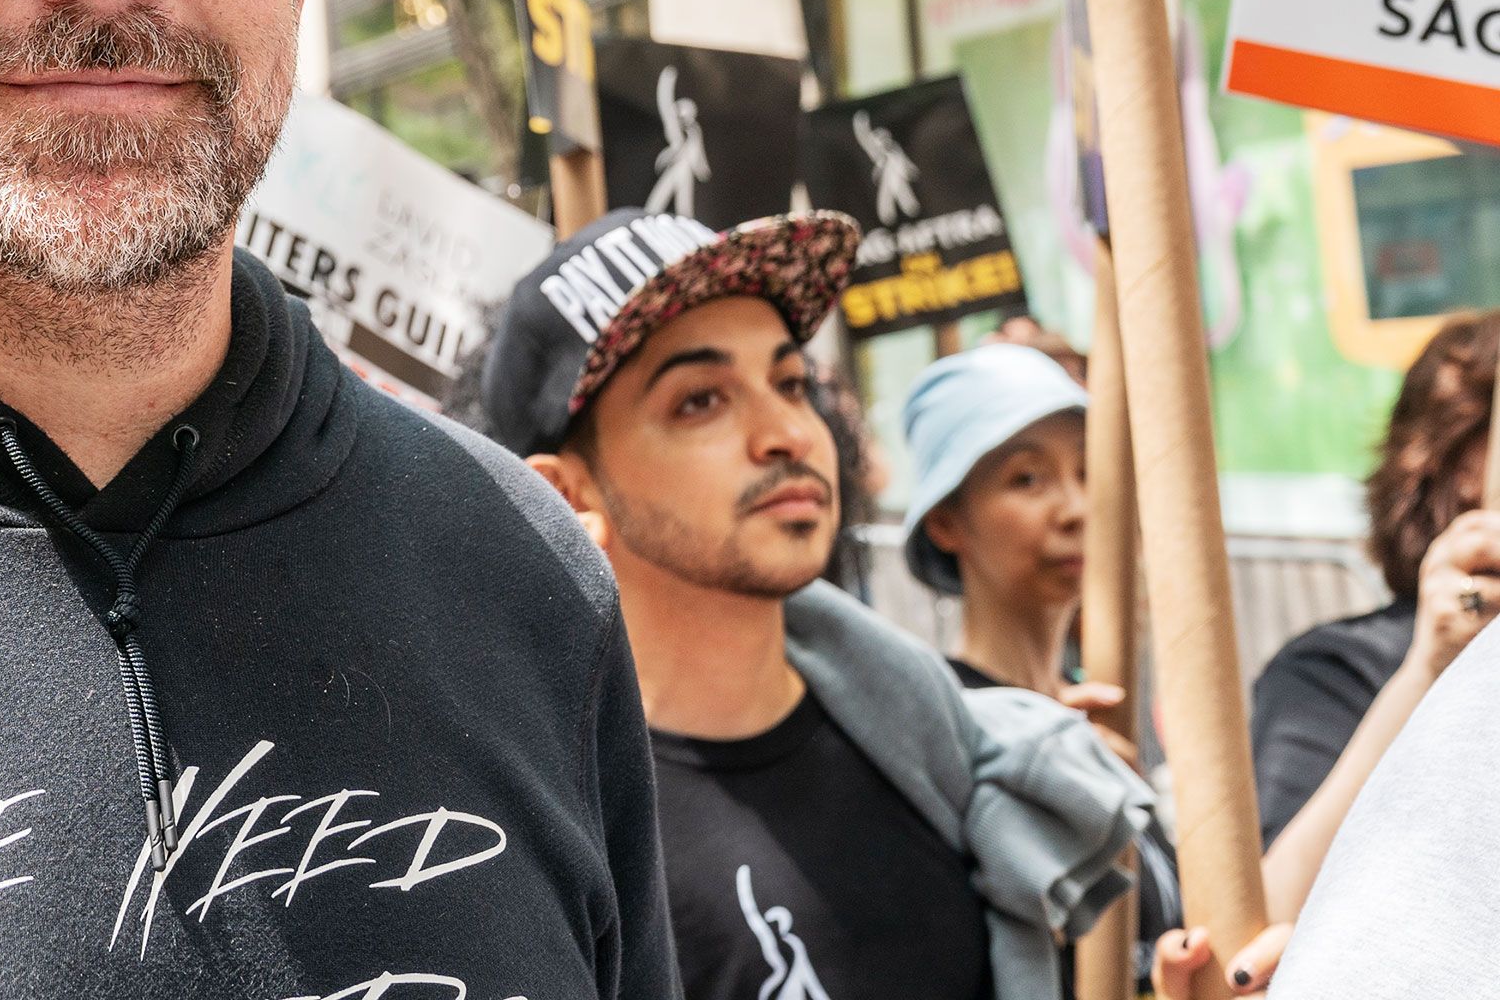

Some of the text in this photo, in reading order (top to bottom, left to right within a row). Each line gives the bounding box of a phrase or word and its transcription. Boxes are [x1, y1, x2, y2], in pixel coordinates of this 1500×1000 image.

[246, 210, 362, 304] ITERS
[539, 244, 629, 345] PAY
[108, 740, 507, 962] NEED
